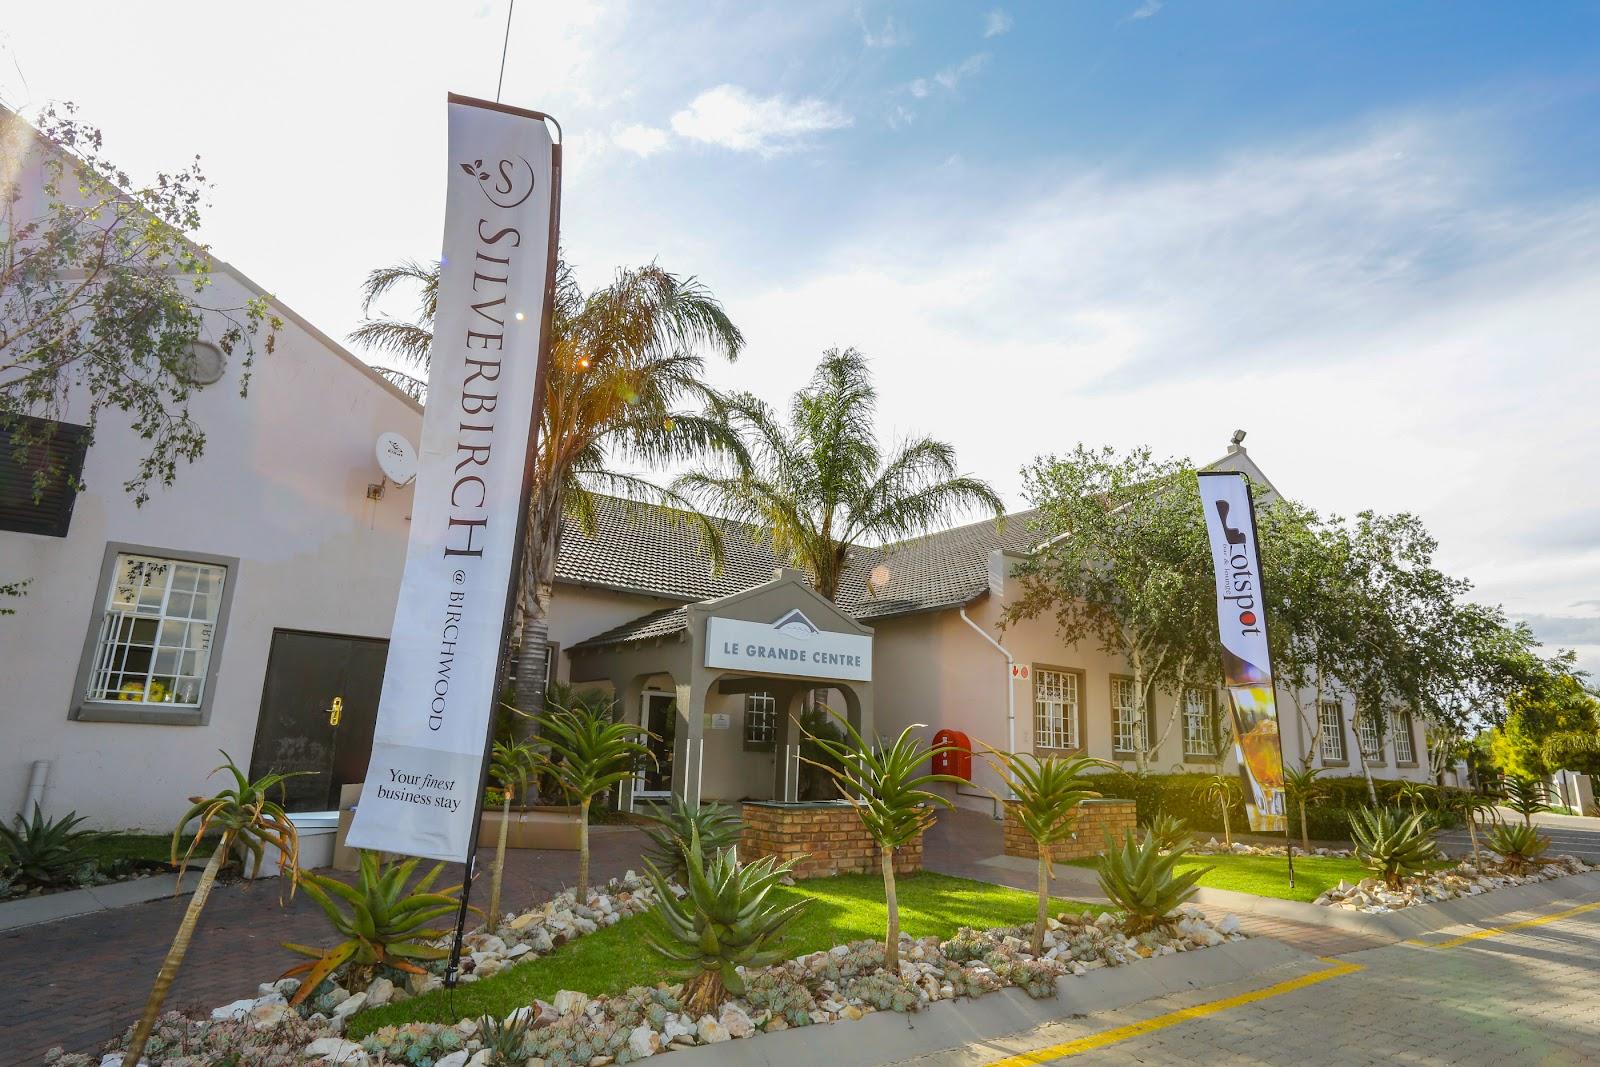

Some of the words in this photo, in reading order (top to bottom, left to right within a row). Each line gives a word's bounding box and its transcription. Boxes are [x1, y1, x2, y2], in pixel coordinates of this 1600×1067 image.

[443, 218, 521, 560] SILVERBIRCH
[452, 569, 466, 585] @
[428, 591, 465, 731] BIRCHWOOD
[724, 642, 739, 655] LE
[746, 645, 806, 661] GRANDE
[812, 652, 861, 667] CENTRE
[390, 768, 421, 785] Your
[419, 773, 455, 791] finest
[377, 785, 432, 806] business
[434, 796, 461, 813] stay
